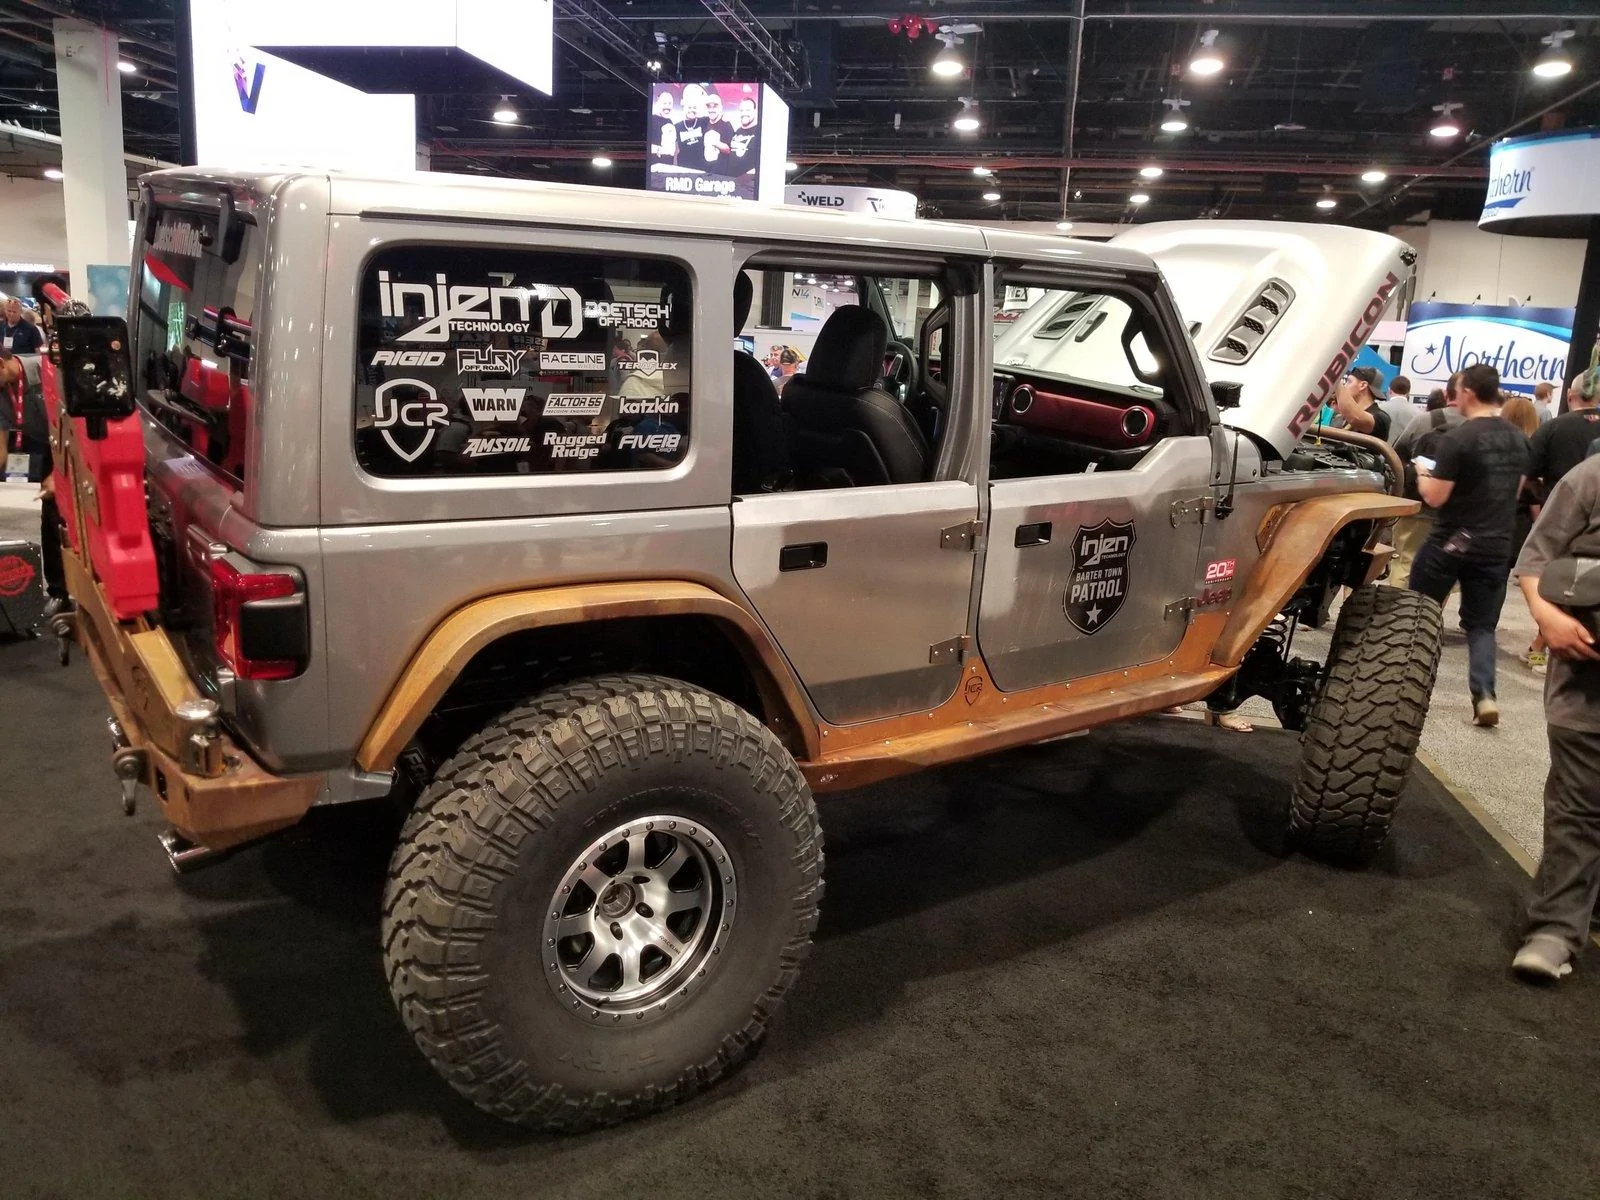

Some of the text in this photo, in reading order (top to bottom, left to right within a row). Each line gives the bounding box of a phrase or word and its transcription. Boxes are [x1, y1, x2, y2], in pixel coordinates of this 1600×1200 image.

[665, 177, 736, 195] RMD Garage
[806, 196, 845, 207] WELD
[378, 270, 530, 342] injen
[584, 301, 669, 319] DOETSCH
[448, 321, 530, 333] TECHNOLOGY
[599, 317, 658, 328] OFF-ROAD
[370, 351, 447, 366] RIGID
[457, 345, 527, 375] FURY
[541, 353, 604, 364] RACELINE
[1286, 271, 1399, 438] RUBICON
[472, 398, 517, 411] WARN
[547, 397, 586, 407] FACTOR
[619, 397, 680, 414] katzkin
[374, 398, 450, 427] JCR
[462, 437, 532, 458] AMSOIL
[543, 432, 608, 447] Rugged
[551, 445, 600, 460] Ridge
[1081, 534, 1129, 567] injen
[1076, 567, 1123, 582] BARTER TOWN
[1070, 579, 1123, 604] PATROL
